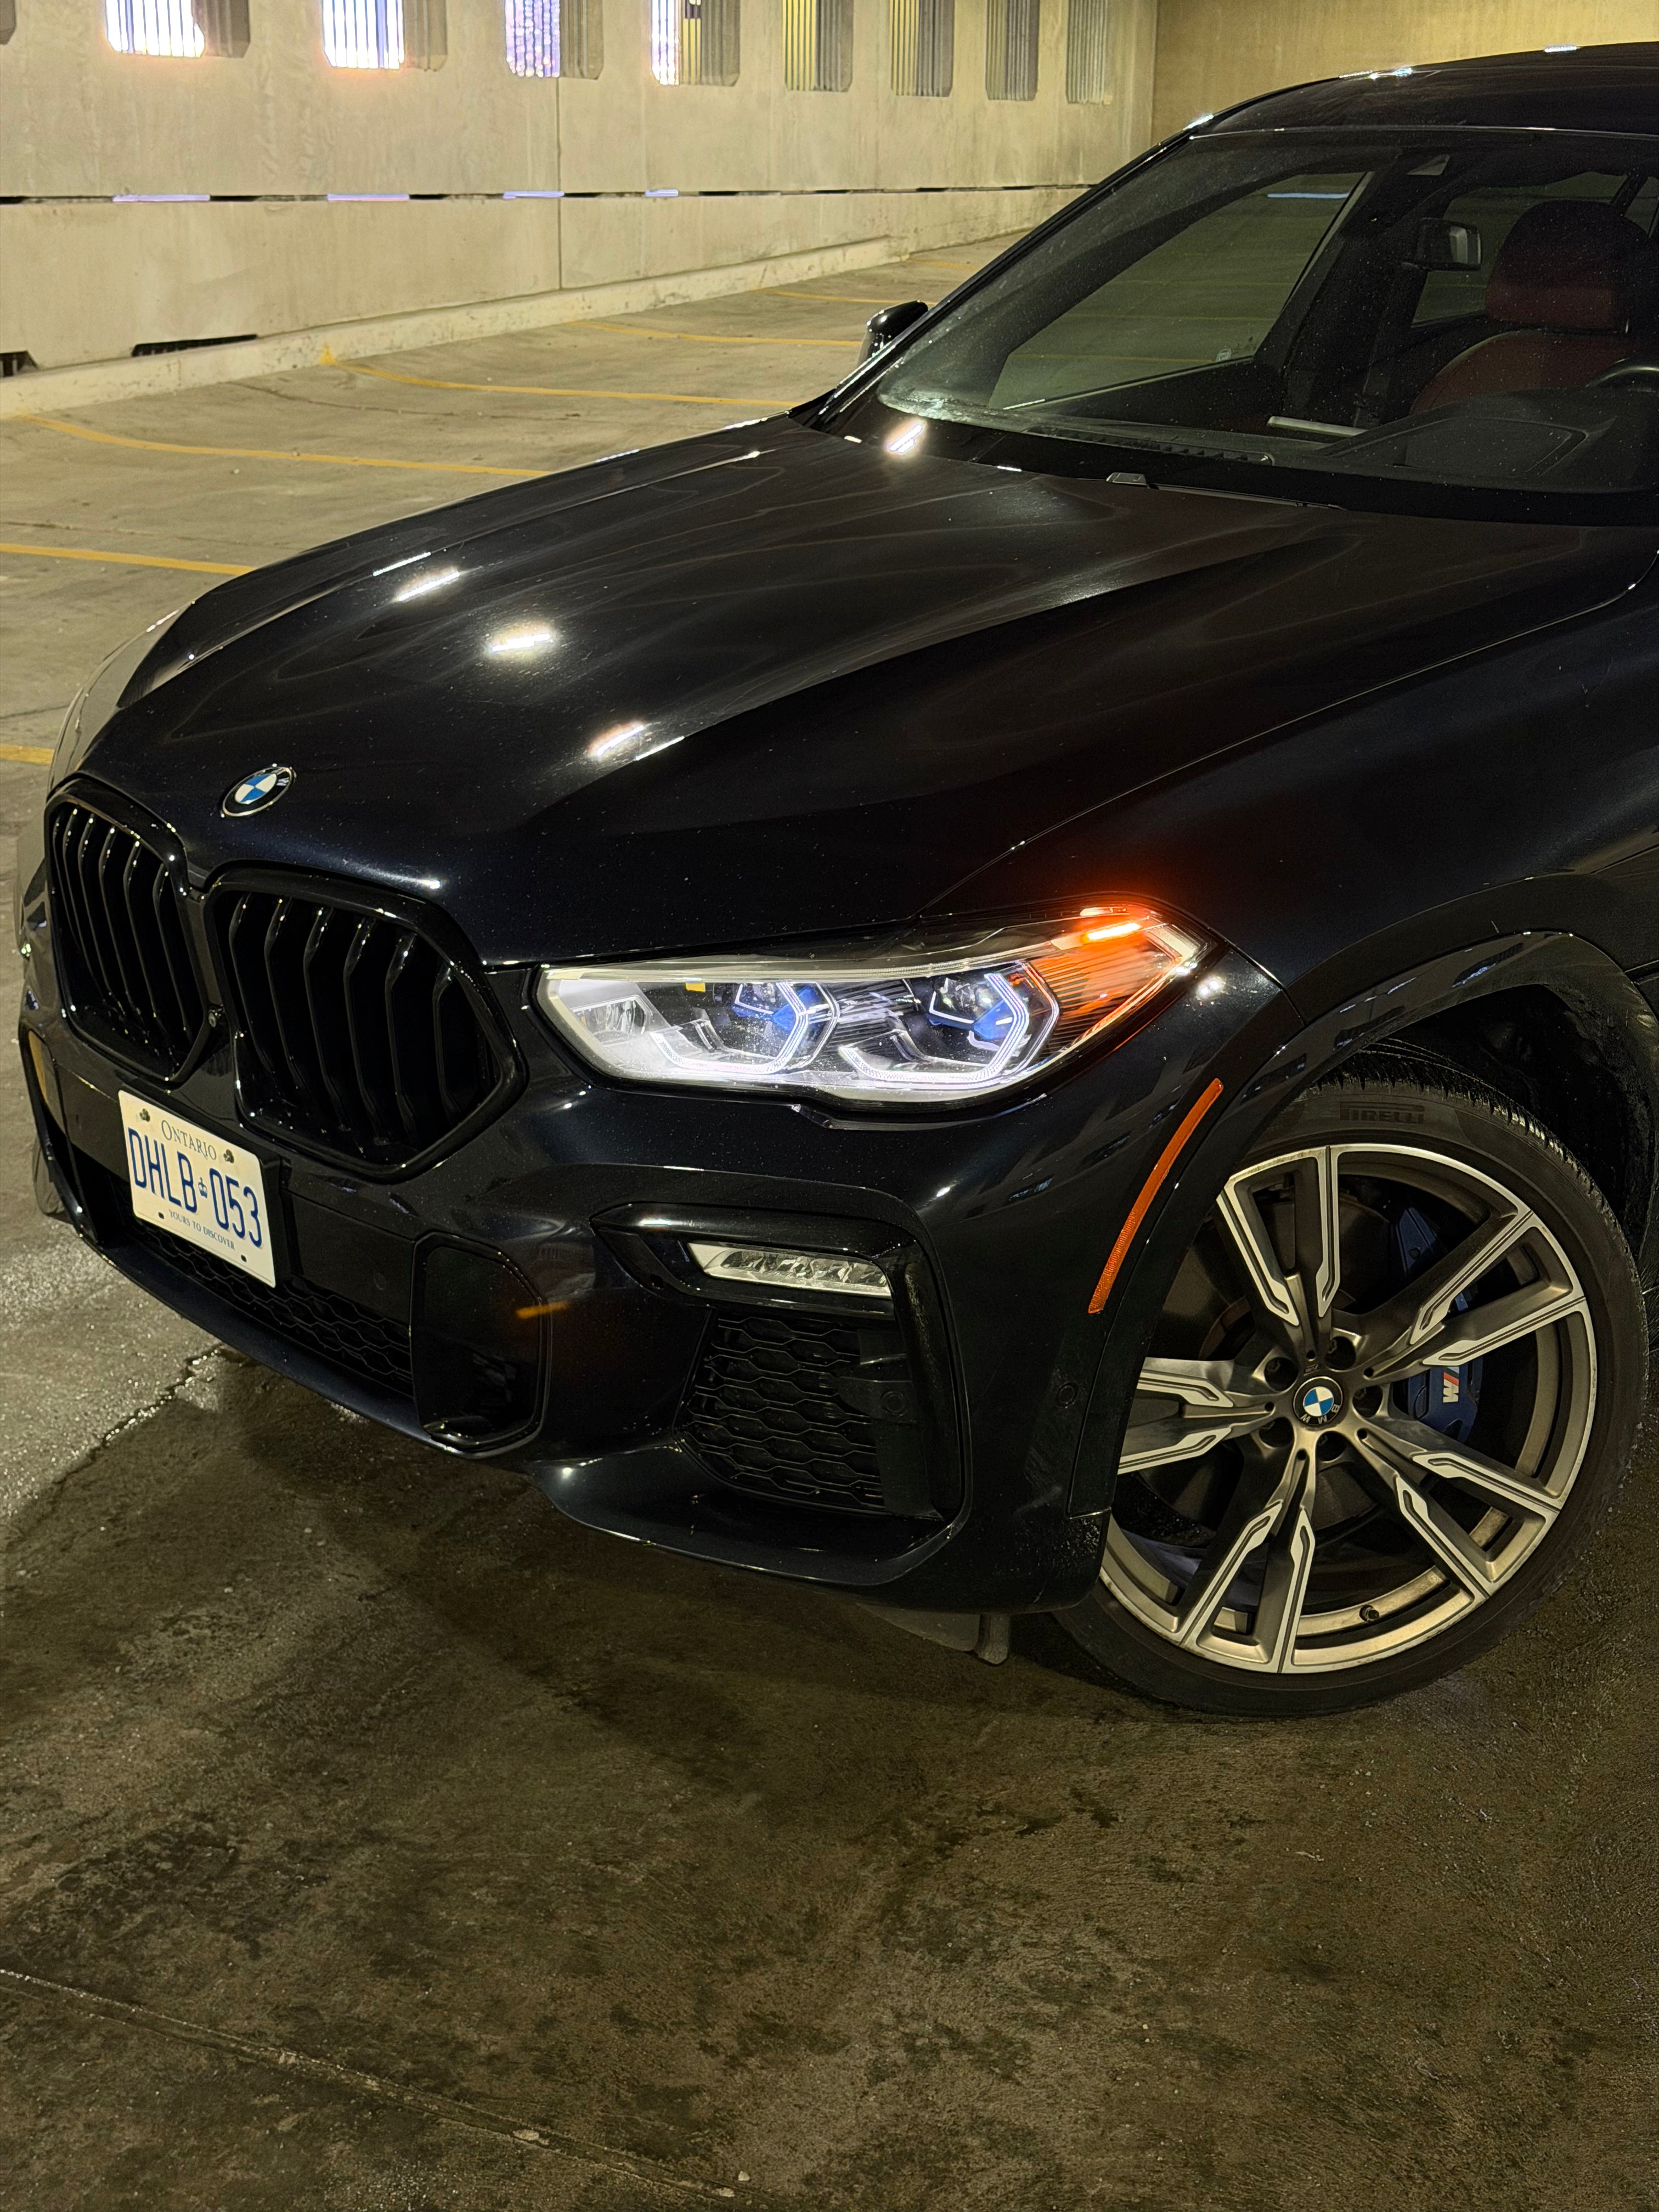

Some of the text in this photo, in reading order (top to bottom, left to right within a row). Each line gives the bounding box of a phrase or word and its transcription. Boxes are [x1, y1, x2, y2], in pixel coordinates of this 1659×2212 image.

[1340, 1102, 1425, 1124] PIRELLI
[161, 1120, 217, 1160] ONTARIO
[128, 1127, 262, 1248] DHLB 053
[168, 1209, 235, 1250] YOURS TO DISCOVER
[1300, 1404, 1341, 1425] BMW
